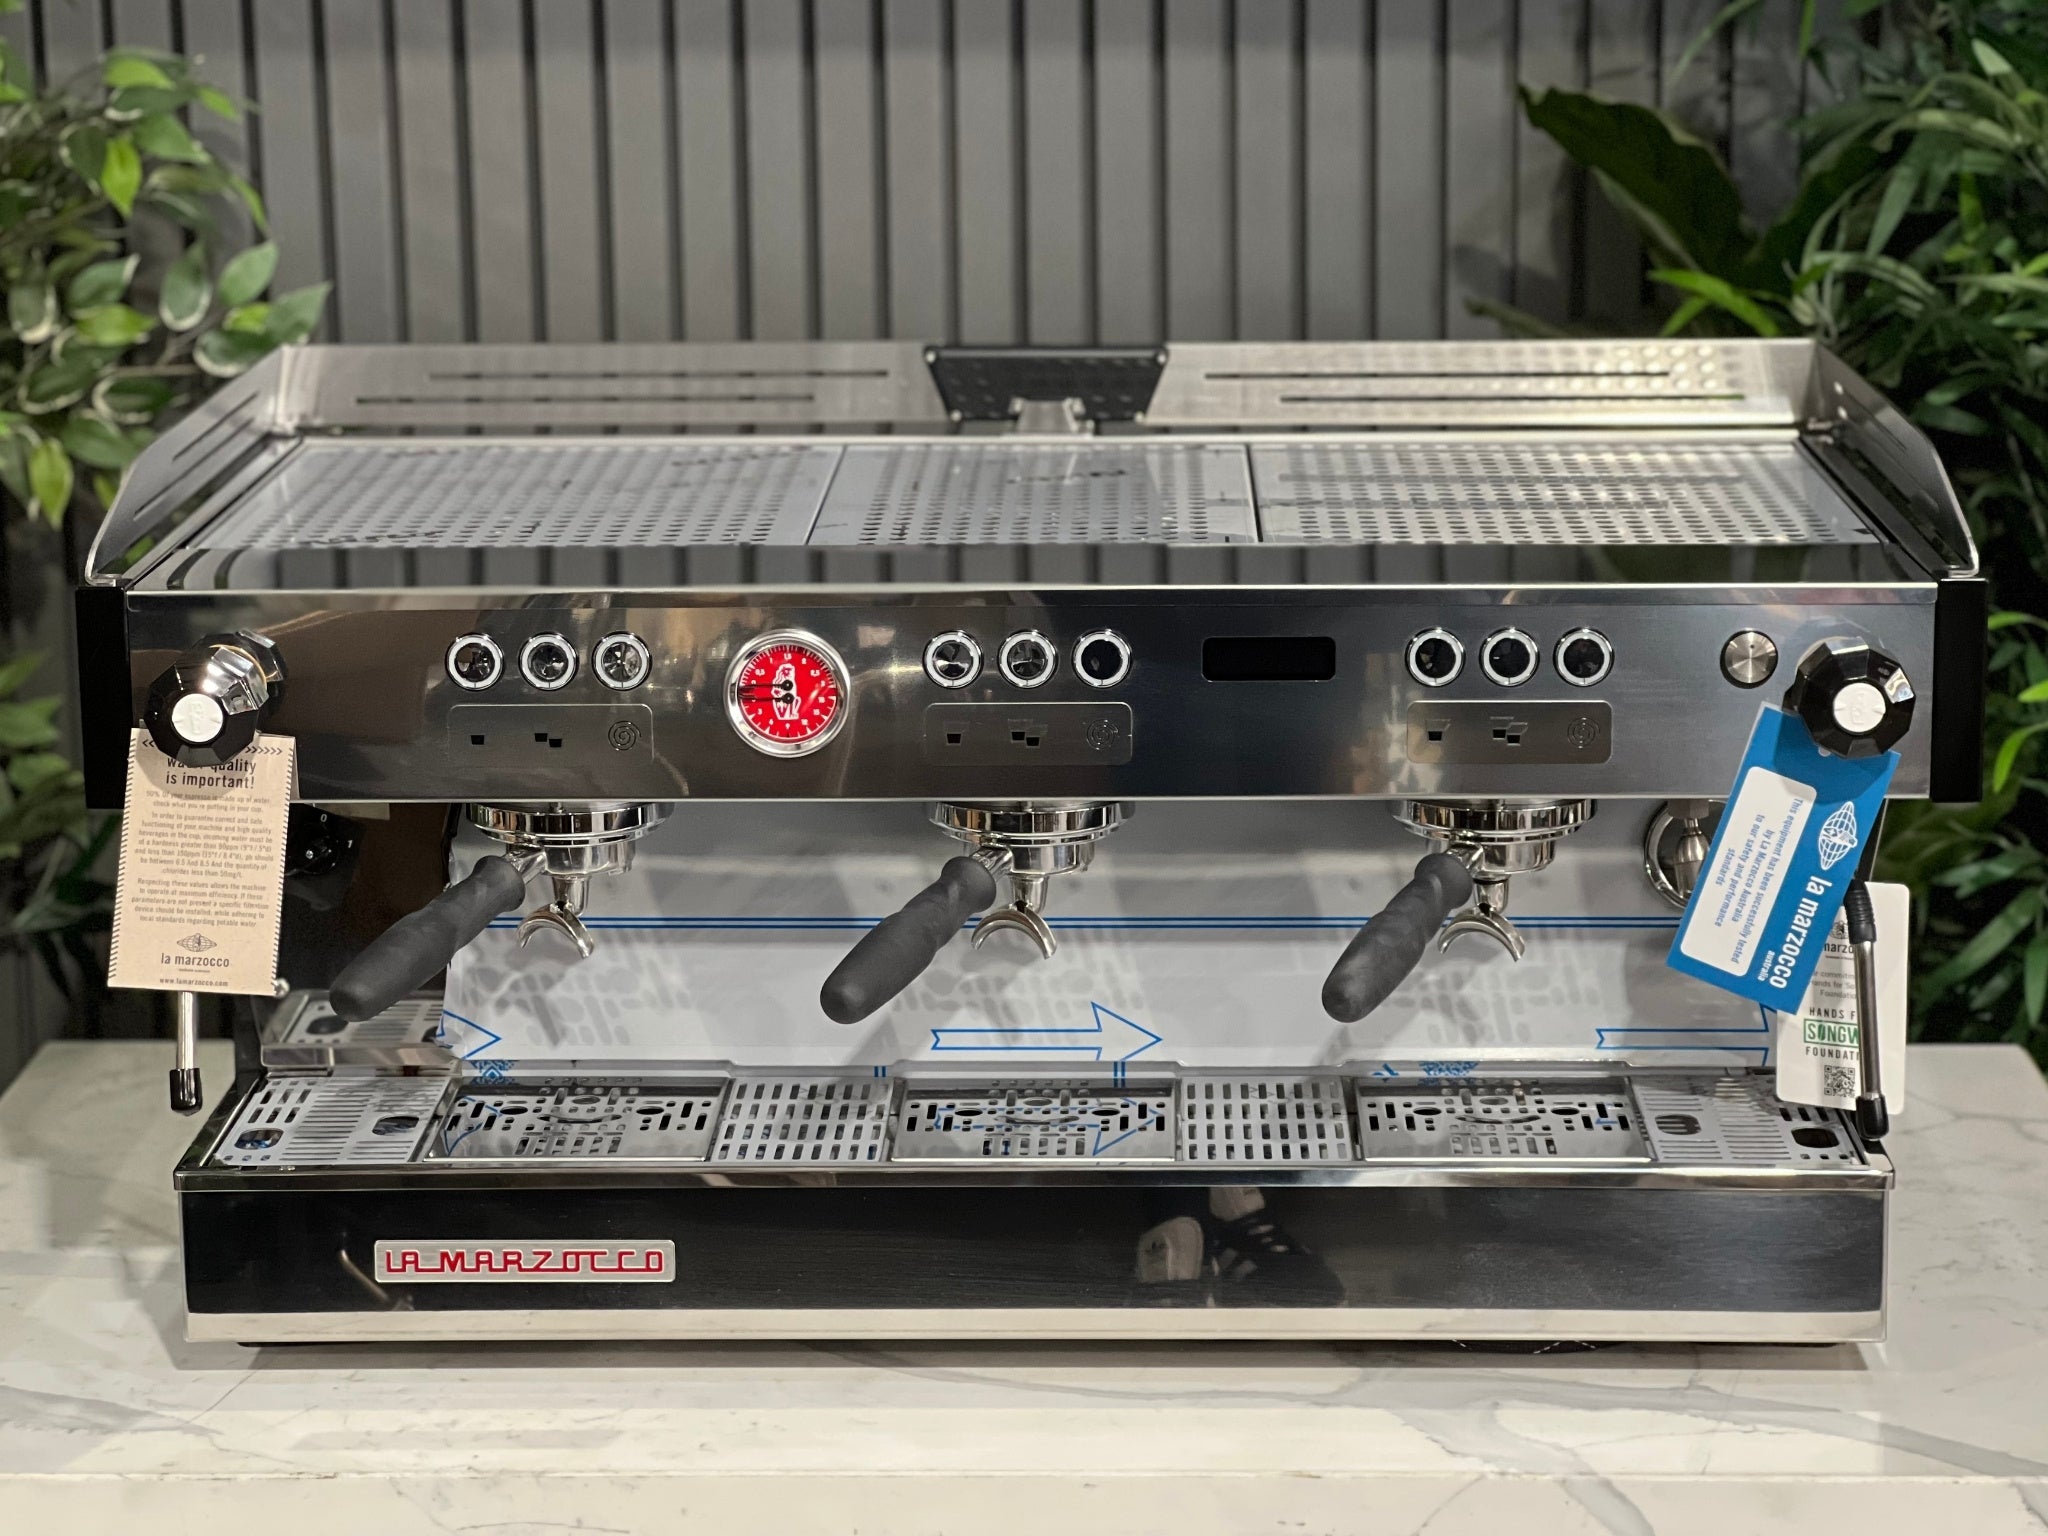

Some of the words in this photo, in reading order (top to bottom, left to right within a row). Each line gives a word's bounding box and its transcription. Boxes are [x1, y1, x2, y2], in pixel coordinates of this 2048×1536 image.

[166, 771, 177, 784] is
[182, 772, 254, 788] important!
[1790, 799, 1803, 813] This
[320, 813, 328, 823] 0
[142, 821, 174, 830] functioning
[237, 826, 250, 834] high
[252, 827, 272, 835] quality
[1751, 824, 1760, 837] our
[1764, 830, 1774, 839] by
[138, 830, 169, 839] beverages
[203, 833, 230, 842] incoming
[1774, 816, 1793, 855] equipment
[152, 839, 179, 847] hardness
[180, 841, 201, 849] greater
[347, 839, 353, 849] 1
[1739, 839, 1753, 862] safety
[1760, 841, 1770, 849] La
[236, 862, 260, 870] quantity
[1716, 849, 1734, 885] standards
[1734, 863, 1744, 878] and
[1746, 852, 1766, 887] Marzocco
[1768, 857, 1779, 870] has
[137, 878, 170, 887] Respecting
[1760, 872, 1773, 890] been
[1807, 876, 1833, 895] la
[147, 888, 170, 896] operate
[179, 889, 208, 897] maximum
[131, 896, 165, 905] parameters
[189, 899, 212, 908] present
[219, 901, 241, 909] specific
[1715, 879, 1738, 926] performance
[1732, 889, 1751, 921] Australia
[156, 906, 174, 914] should
[231, 911, 256, 919] adhering
[1740, 893, 1763, 938] successfully
[187, 917, 215, 926] regarding
[216, 919, 239, 928] potable
[1771, 898, 1818, 988] marzocco
[1824, 943, 1854, 953] marzo
[1731, 940, 1746, 963] tested
[161, 953, 170, 964] la
[175, 955, 229, 967] marzocco
[1758, 950, 1775, 981] australia
[160, 978, 228, 986] www.lamarzocco.com
[1820, 990, 1856, 999] Foundatio
[1810, 1007, 1844, 1019] HANDS
[1808, 1022, 1859, 1044] SONGW
[1806, 1046, 1860, 1060] FOUNDATI
[386, 1250, 419, 1272] LA
[440, 1250, 663, 1272] MARZOCCO
